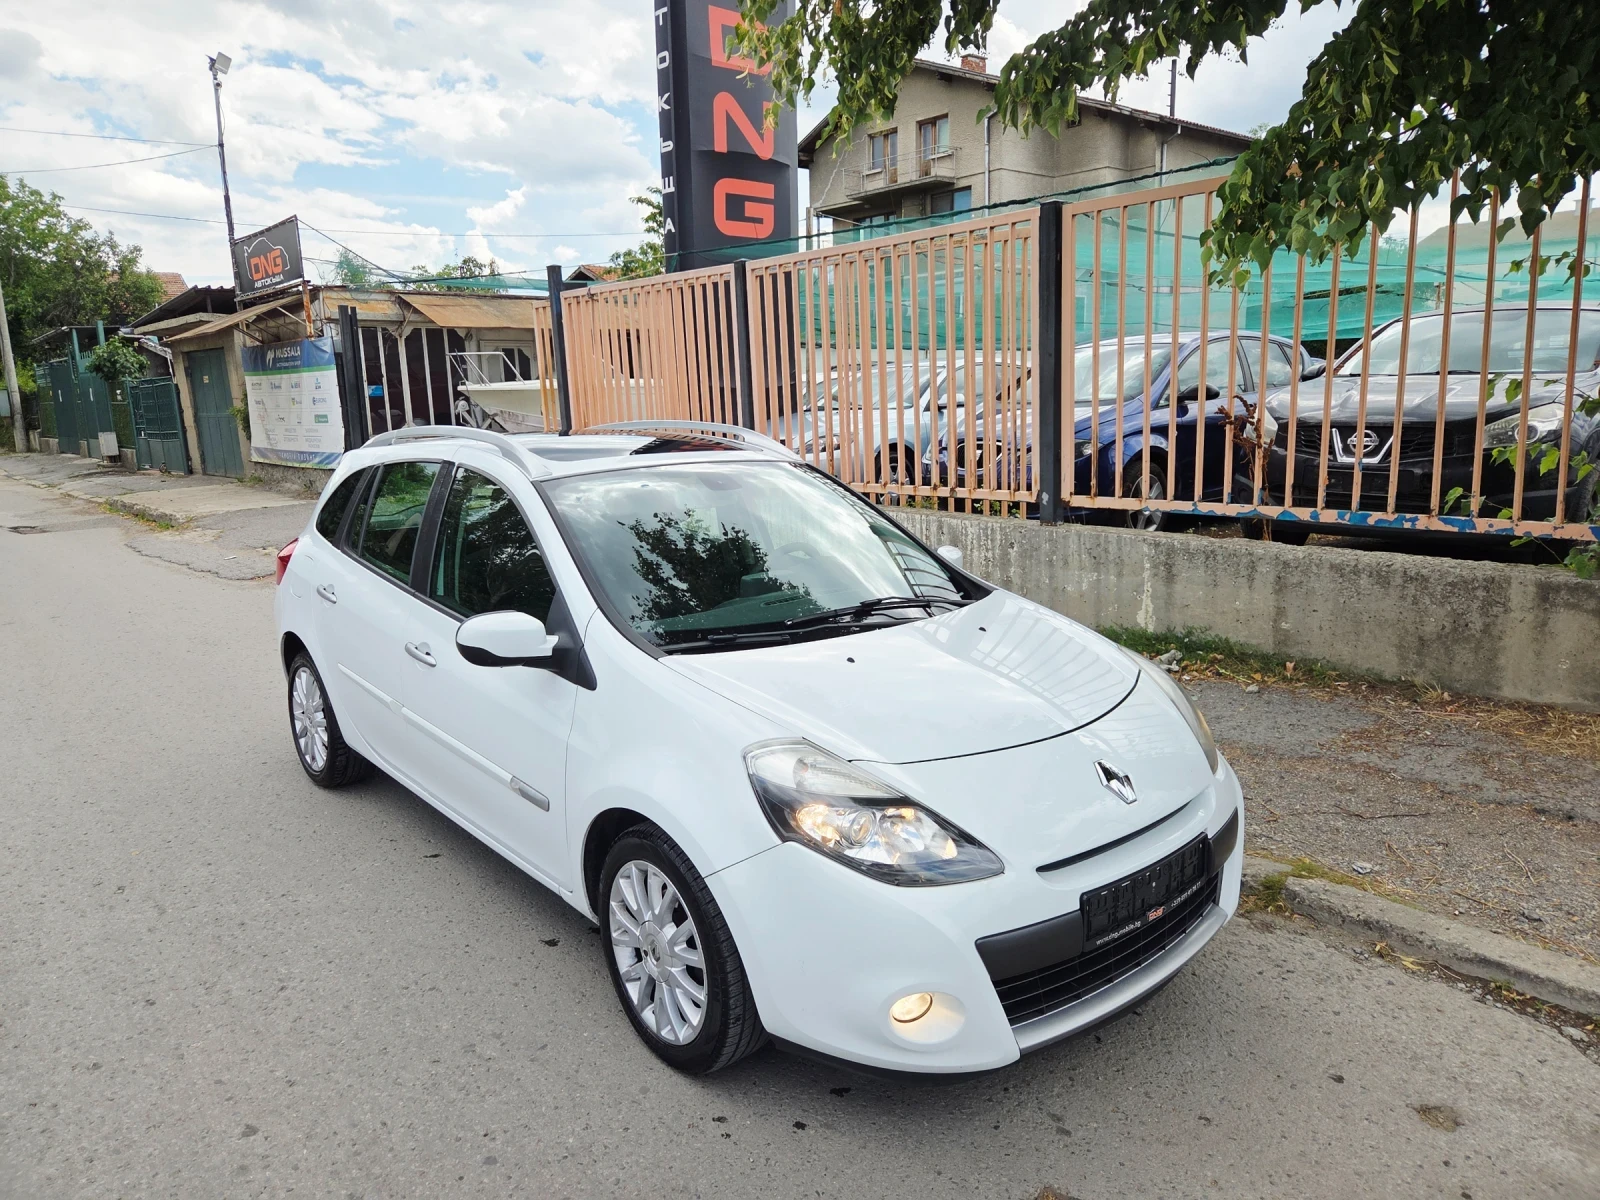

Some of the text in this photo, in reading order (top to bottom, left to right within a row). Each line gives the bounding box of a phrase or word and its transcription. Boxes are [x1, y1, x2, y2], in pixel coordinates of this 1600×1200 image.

[708, 5, 774, 239] DNG
[250, 248, 283, 281] DNG
[275, 346, 301, 359] MUSSALA
